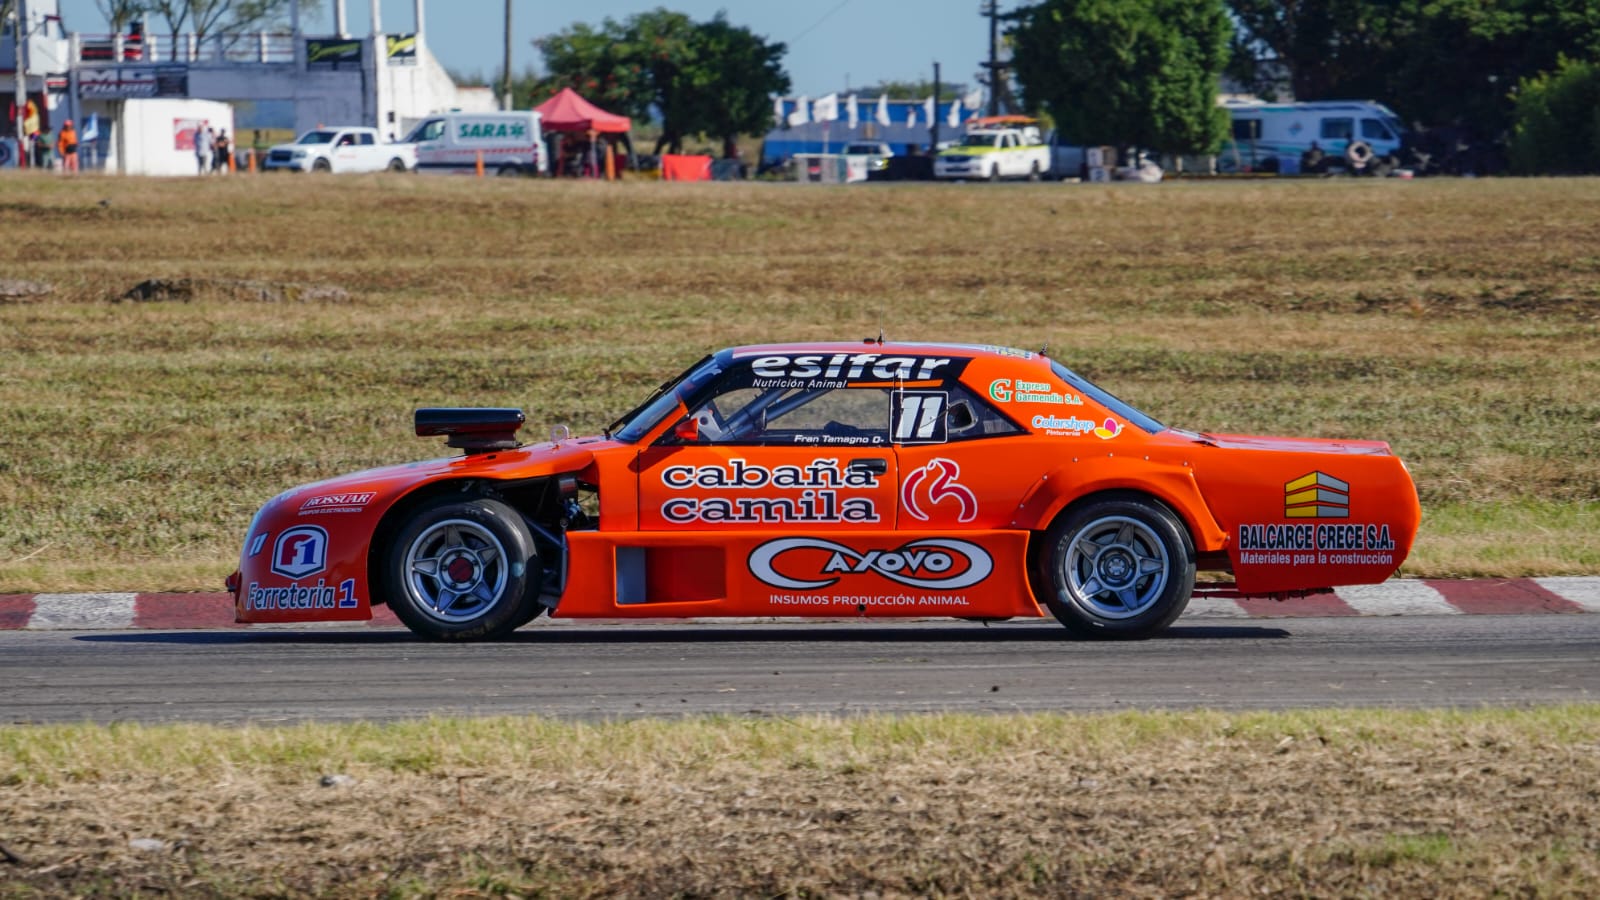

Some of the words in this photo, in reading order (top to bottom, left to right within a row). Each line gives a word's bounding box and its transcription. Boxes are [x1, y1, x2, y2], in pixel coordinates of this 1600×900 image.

[459, 123, 507, 137] SARA
[751, 353, 950, 380] esifar
[752, 378, 804, 389] Nutrición
[807, 378, 848, 390] Animal
[1015, 380, 1051, 392] Expreso
[1015, 391, 1064, 403] Garmendia
[896, 397, 943, 439] 11
[1032, 415, 1096, 434] Colorshop
[794, 434, 820, 443] Fran
[822, 435, 869, 445] Tamagno
[660, 458, 879, 488] cabaña
[660, 490, 881, 523] camila
[1239, 524, 1314, 550] BALCARCE
[1316, 524, 1365, 550] CRECE
[1366, 524, 1395, 550] S.A.
[279, 534, 317, 566] F1
[1240, 552, 1291, 564] Materiales
[1293, 555, 1316, 566] para
[1318, 552, 1327, 564] la
[1329, 551, 1393, 564] construcción
[338, 578, 358, 609] 1
[769, 594, 829, 605] INSUMOS
[832, 593, 915, 606] PRODUCCIÓN
[918, 595, 970, 606] ANIMAL
